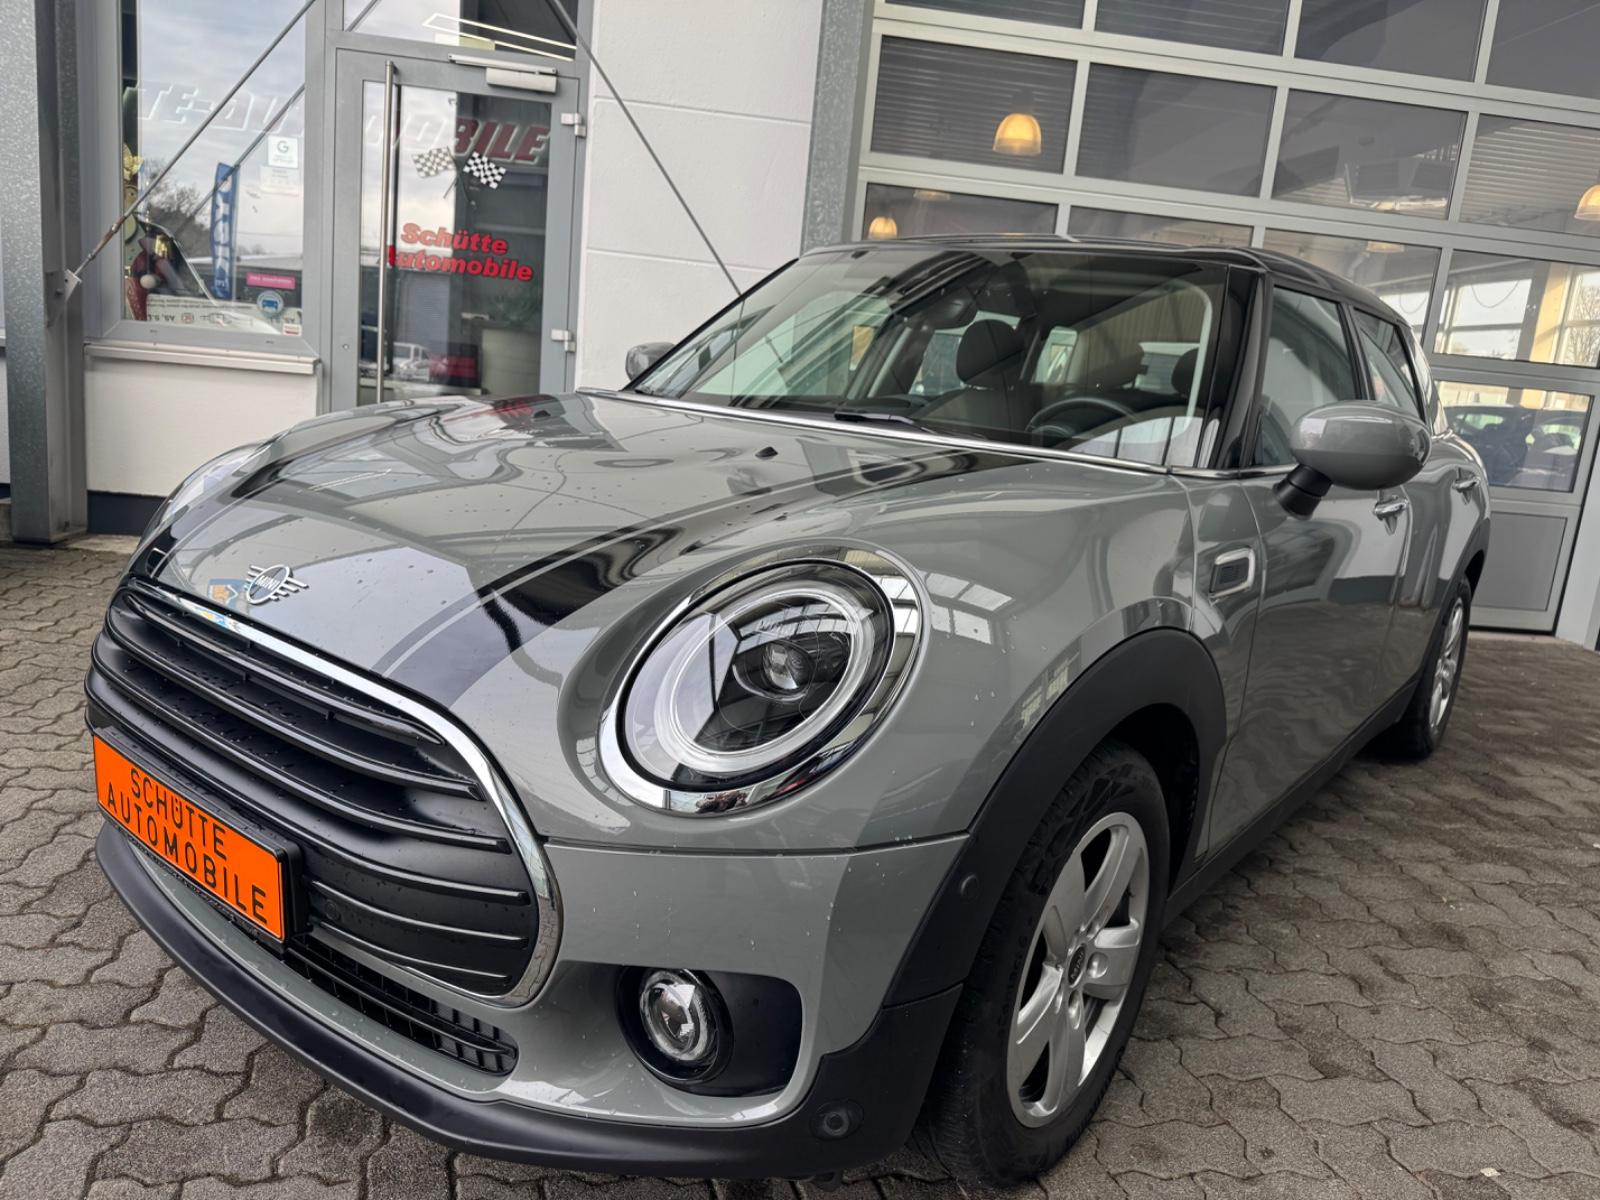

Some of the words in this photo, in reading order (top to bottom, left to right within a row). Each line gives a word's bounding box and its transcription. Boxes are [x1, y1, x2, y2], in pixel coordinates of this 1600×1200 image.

[401, 223, 508, 255] Schütte
[255, 575, 281, 591] MINI
[130, 767, 227, 861] SCHÜTTE
[107, 781, 268, 924] AUTOMOBILE
